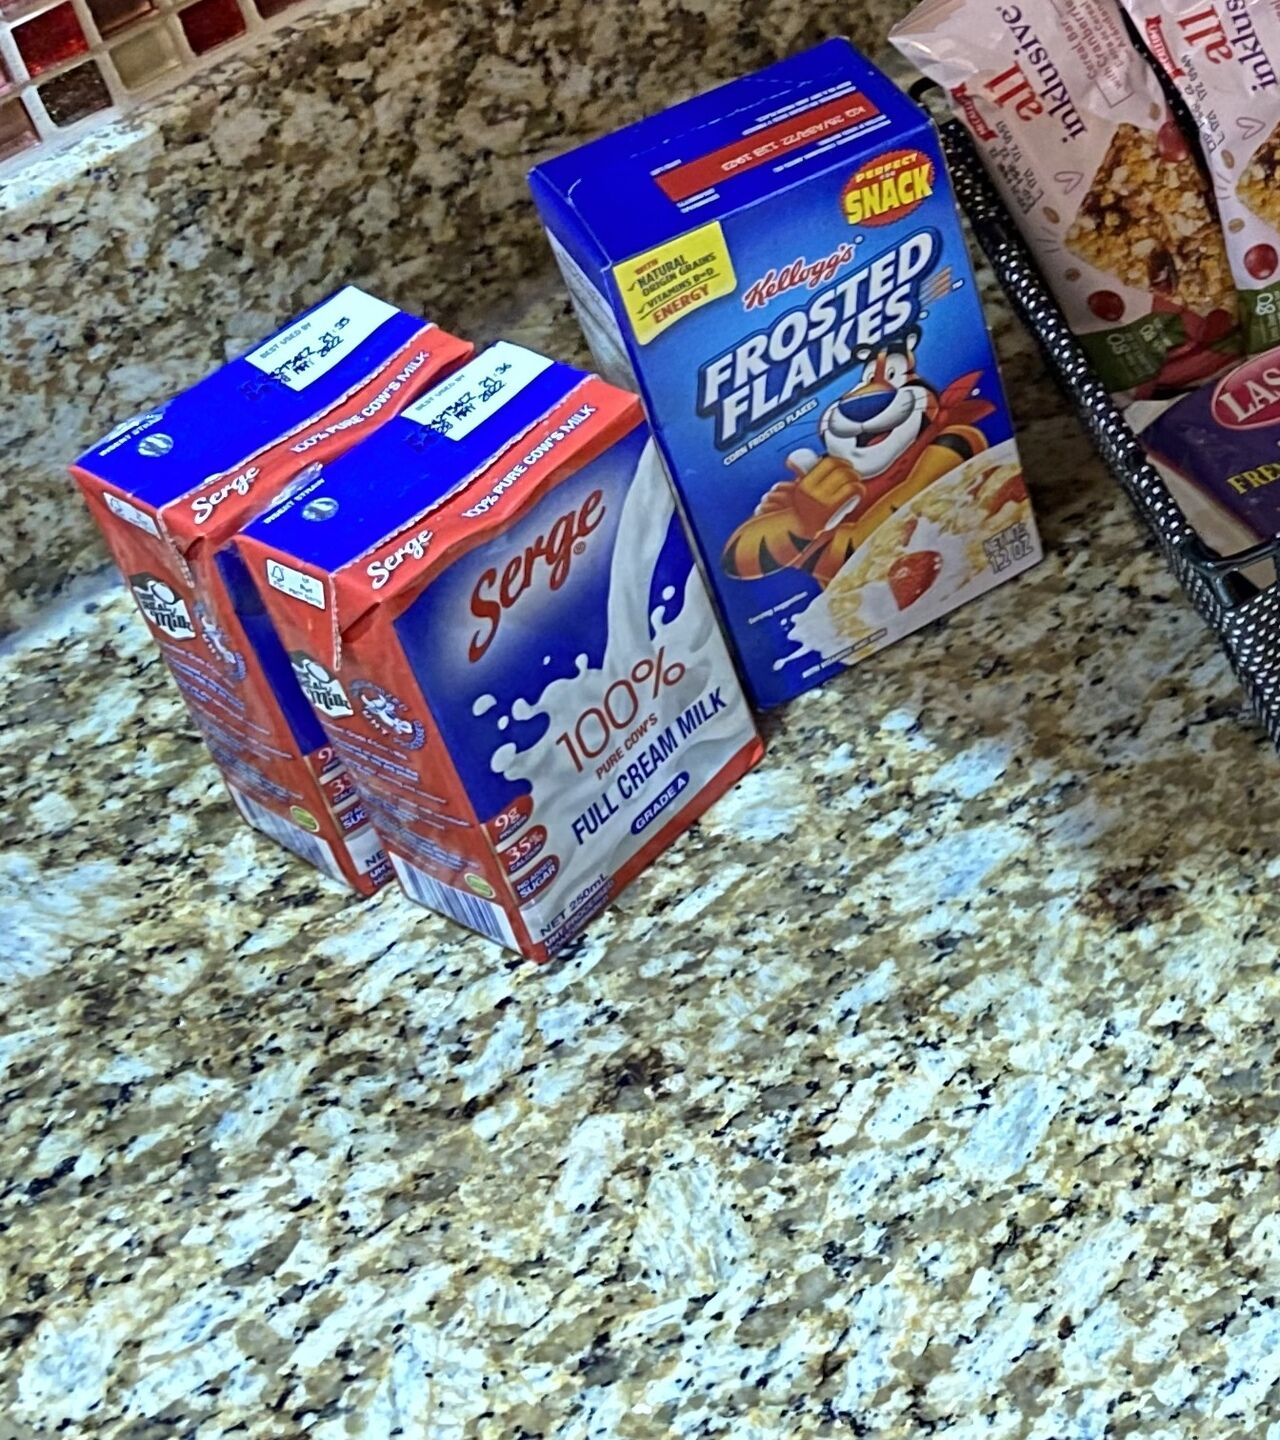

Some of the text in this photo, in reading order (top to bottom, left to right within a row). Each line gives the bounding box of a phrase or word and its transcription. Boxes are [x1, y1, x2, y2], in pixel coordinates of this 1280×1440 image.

[1177, 3, 1234, 66] all
[982, 62, 1045, 122] all
[994, 3, 1088, 144] inklusive
[844, 162, 933, 226] SNACK
[855, 152, 920, 184] PERFECT
[637, 254, 689, 288] NATURAL
[647, 279, 692, 309] VITAMINS
[743, 244, 856, 310] Kellogg's
[651, 284, 710, 324] ENERGY
[702, 231, 934, 410] FROSTED
[1252, 291, 1276, 316] 80
[720, 284, 914, 442] FLAKES
[290, 432, 328, 455] 100%
[327, 413, 363, 436] PURE
[363, 382, 400, 417] COW'S
[397, 349, 431, 384] MILK
[461, 403, 597, 519] 100% PURE COW'S MILK
[724, 399, 819, 466] CORN FROSTED FLAKES
[190, 465, 261, 525] Serge
[366, 527, 434, 591] Serge
[468, 489, 606, 664] Serge
[1013, 535, 1034, 558] OZ
[153, 609, 194, 633] Milk
[306, 686, 352, 711] Milk
[555, 646, 686, 774] 100%
[571, 686, 728, 846] FULL CREAM MILK
[594, 712, 658, 780] PURE COW'S
[343, 809, 368, 829] SUG
[494, 806, 519, 830] 9g
[634, 776, 688, 830] GRADE A
[364, 851, 386, 866] NE
[504, 831, 544, 865] 35%
[516, 860, 552, 892] NO ADDED
[519, 863, 557, 898] SUGAR
[540, 872, 609, 937] NET 250mL
